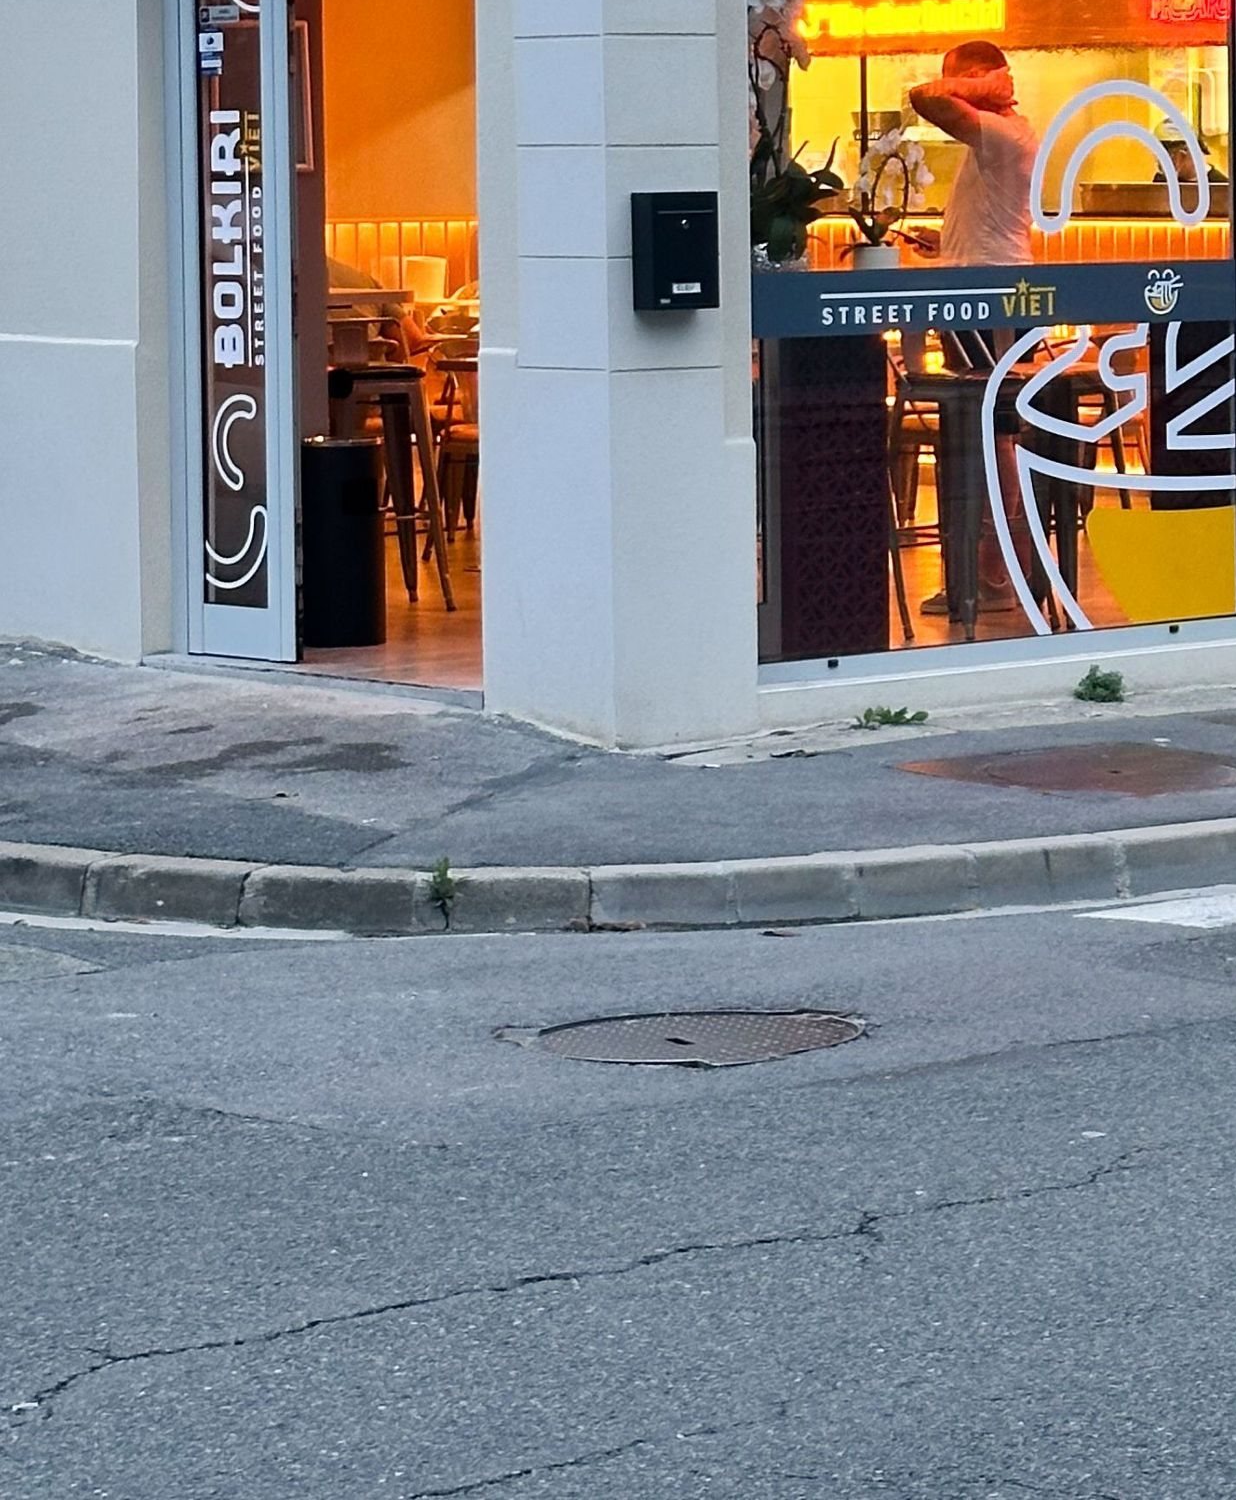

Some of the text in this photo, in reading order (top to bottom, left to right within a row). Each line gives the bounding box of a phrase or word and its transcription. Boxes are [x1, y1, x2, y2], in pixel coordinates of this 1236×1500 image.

[210, 110, 245, 369] BOLKIRI
[252, 186, 263, 254] FOOD
[253, 270, 266, 367] STREET
[821, 288, 1056, 326] STREET FOOD VIET
